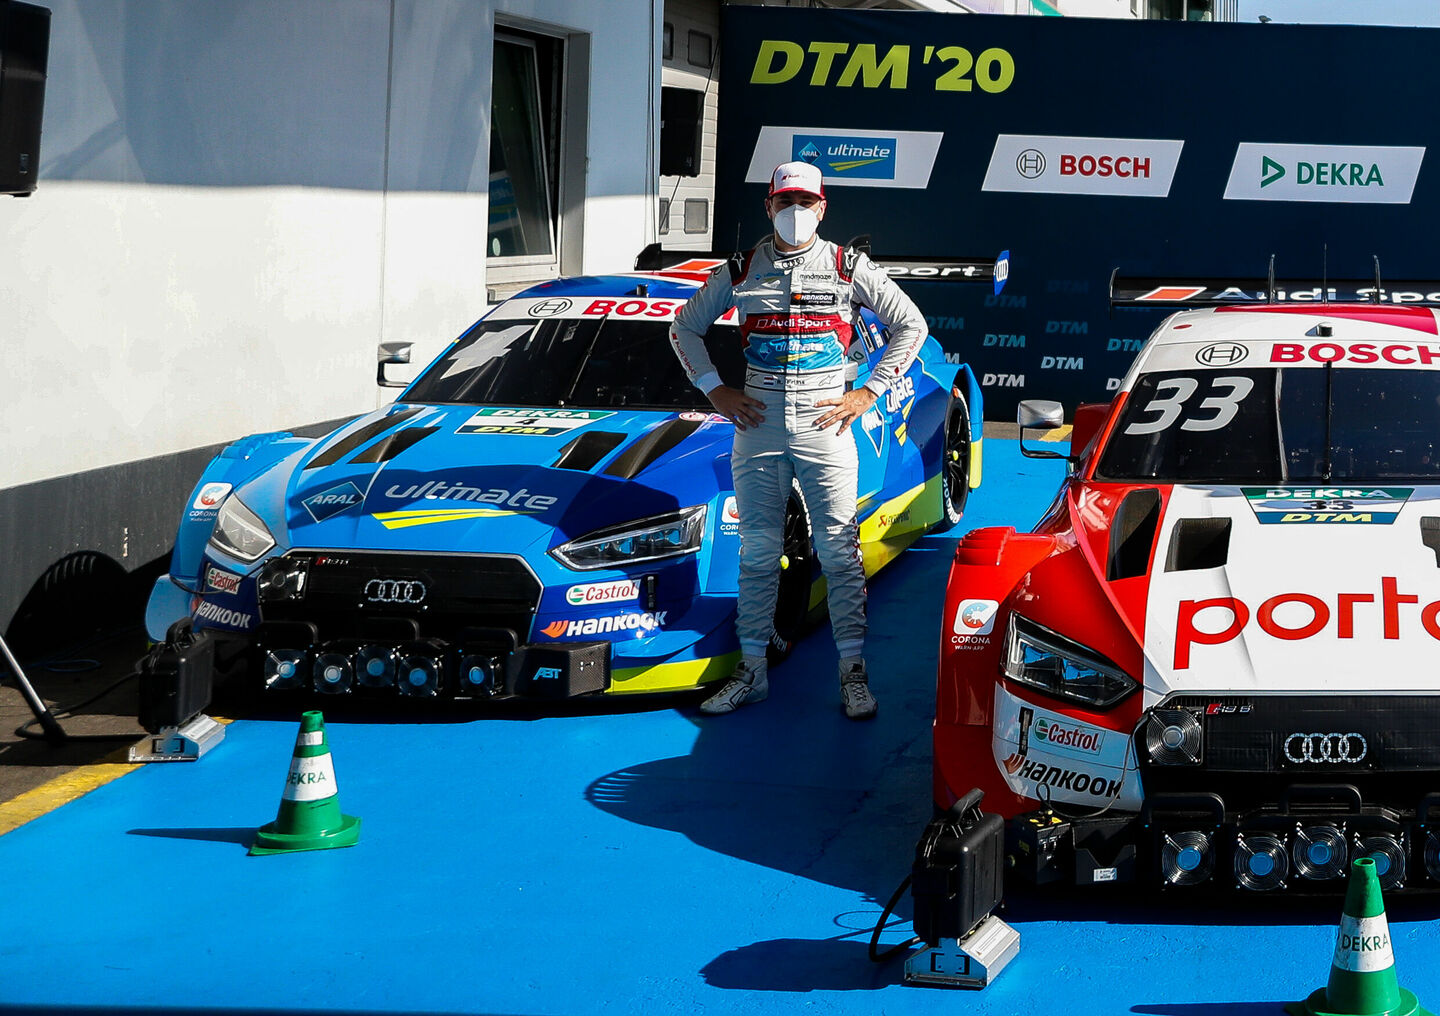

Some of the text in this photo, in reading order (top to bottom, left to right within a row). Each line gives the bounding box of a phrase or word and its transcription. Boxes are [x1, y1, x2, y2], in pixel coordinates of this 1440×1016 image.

[750, 39, 1015, 94] DTM '20
[801, 144, 891, 159] ARAL ultimate
[1059, 154, 1151, 179] BOSCH
[1296, 161, 1385, 187] DEKRA
[886, 265, 978, 280] port
[769, 318, 831, 329] Audi Sport
[1045, 320, 1089, 335] DTM
[982, 333, 1026, 348] DTM
[1040, 355, 1084, 371] DTM
[981, 372, 1025, 388] DTM
[1123, 376, 1255, 436] 33
[489, 409, 593, 419] DEKRA
[472, 425, 550, 434] DTM
[311, 493, 356, 506] ARAL
[385, 479, 559, 511] ultimate
[1265, 488, 1393, 499] DEKRA
[1301, 499, 1354, 511] 33
[1280, 512, 1372, 523] DTM
[585, 583, 638, 602] Castrol
[951, 635, 991, 645] CORONA
[532, 667, 563, 681] ABT
[1047, 722, 1100, 752] Castrol
[1341, 932, 1390, 953] DEKRA
